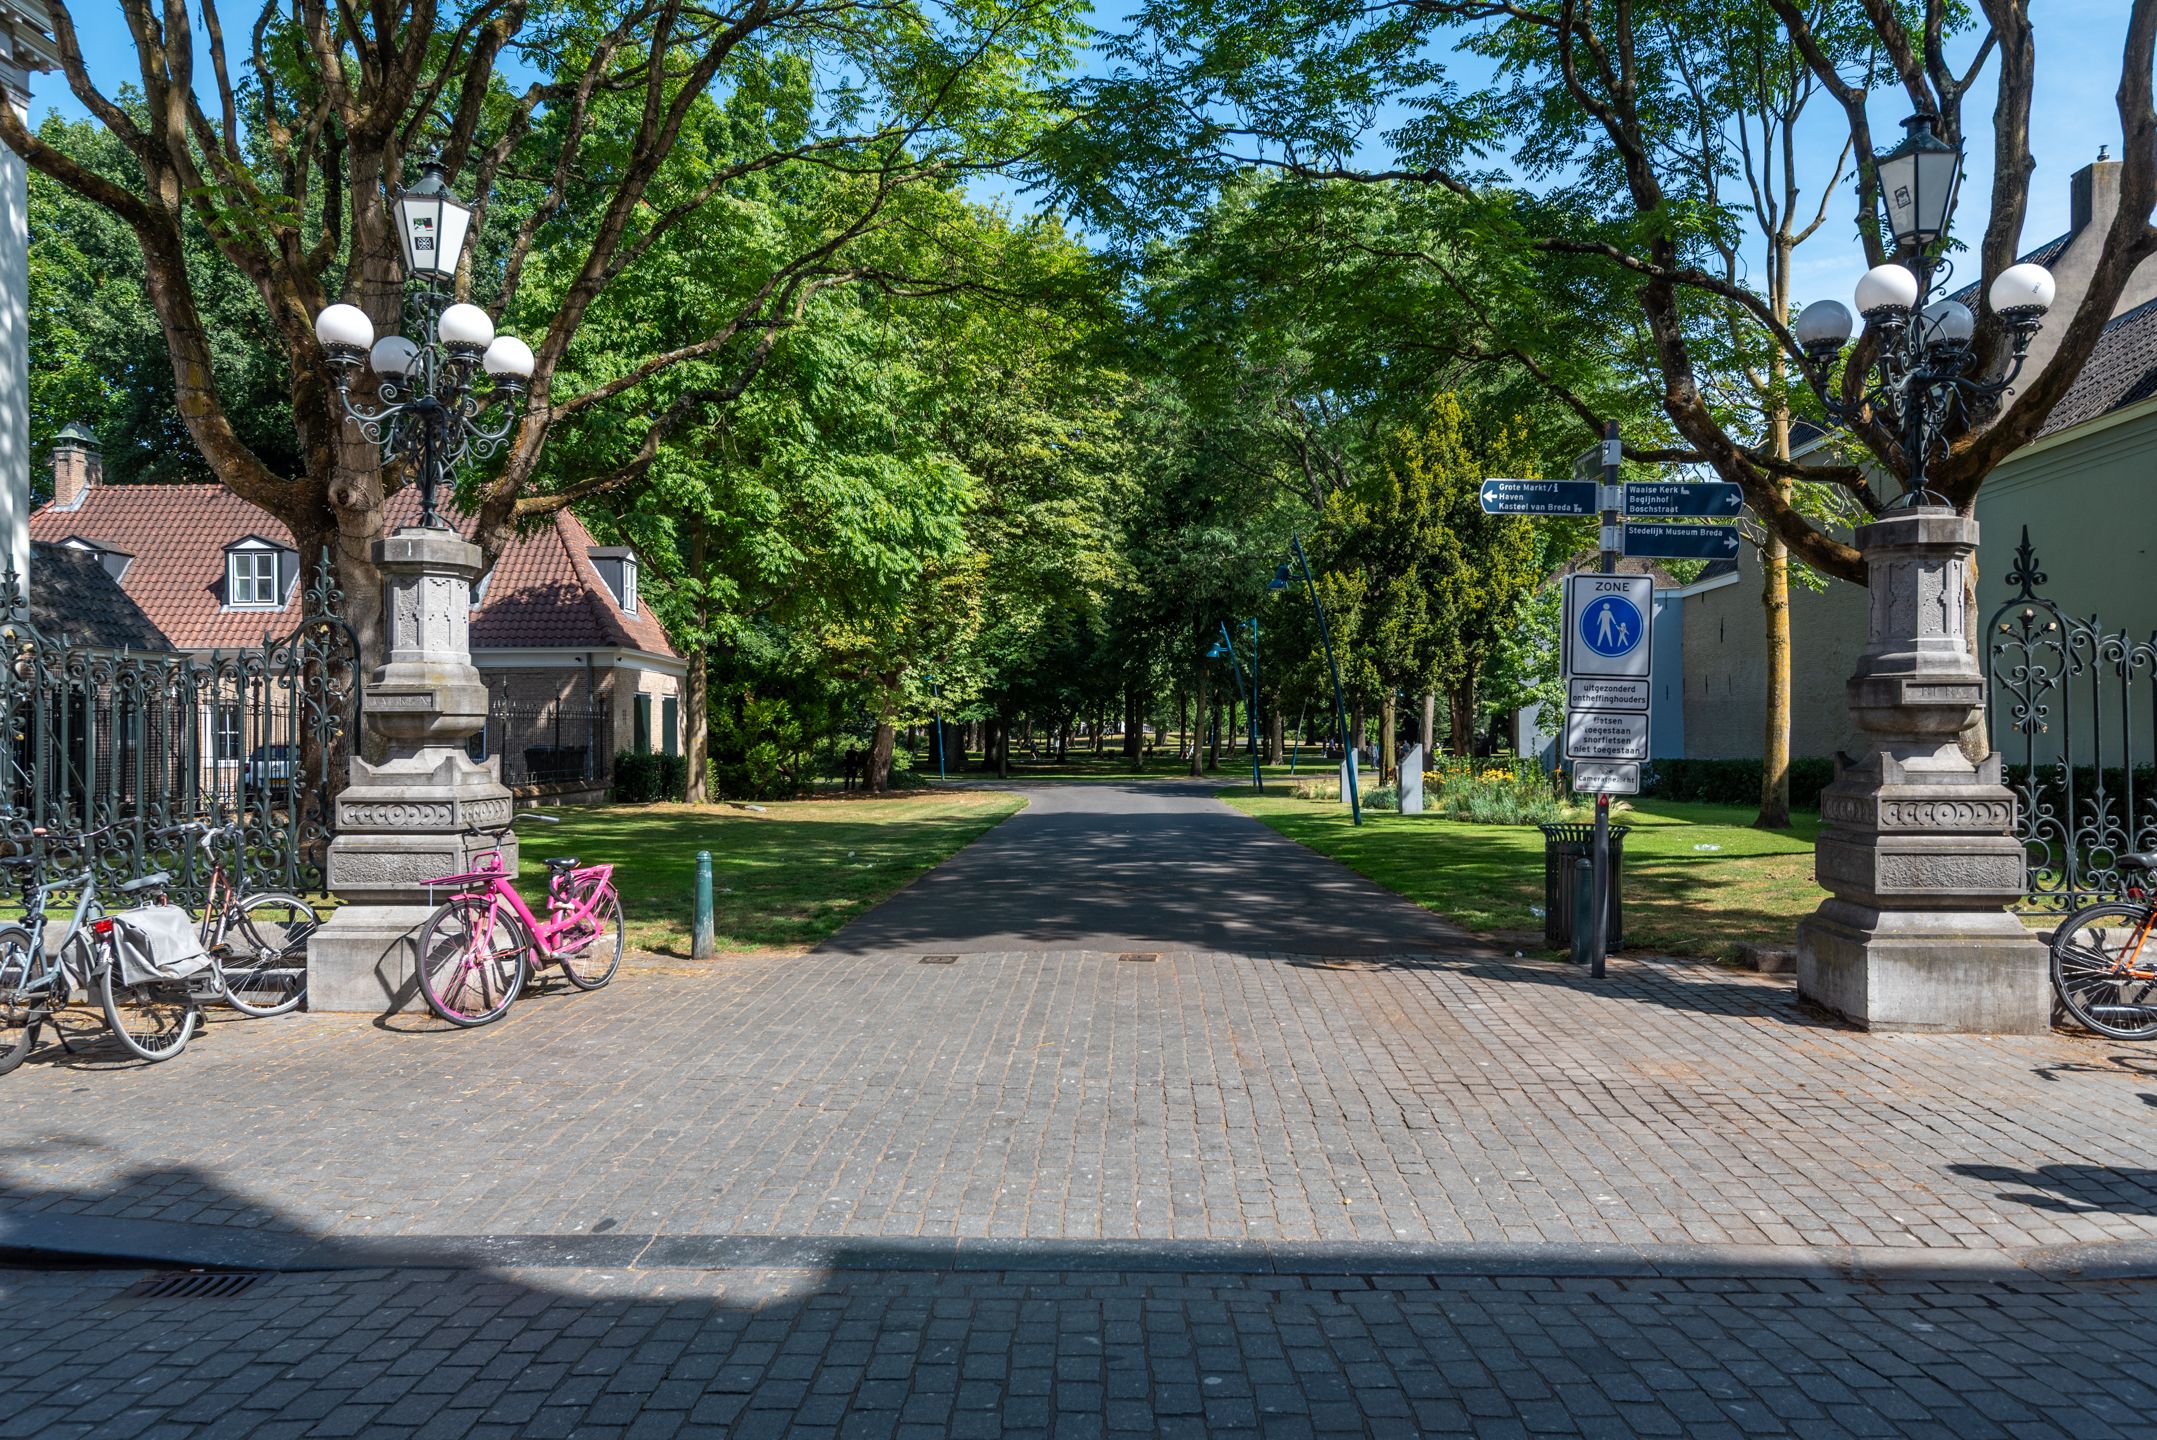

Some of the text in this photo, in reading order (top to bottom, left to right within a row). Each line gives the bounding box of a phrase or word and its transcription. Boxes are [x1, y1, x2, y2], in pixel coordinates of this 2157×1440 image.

[1499, 483, 1521, 491] Grote
[1629, 486, 1678, 494] Waalse Kerk
[1629, 495, 1669, 505] Begijnhof
[1499, 502, 1528, 510] Kasteel
[1548, 503, 1571, 511] Breda
[1629, 505, 1679, 513] Boschstraat
[1628, 526, 1723, 536] Stedelijk Museum Breda
[1595, 581, 1630, 592] ZONE
[1583, 684, 1636, 693] uitgezonderd
[1572, 694, 1646, 704] ontheffinghouders
[1593, 717, 1623, 725] fietsen
[1584, 727, 1631, 736] toegestaan
[1583, 736, 1631, 744] snorfietsen
[1593, 746, 1641, 756] toegestaan
[1578, 775, 1635, 784] Cameratoecht
